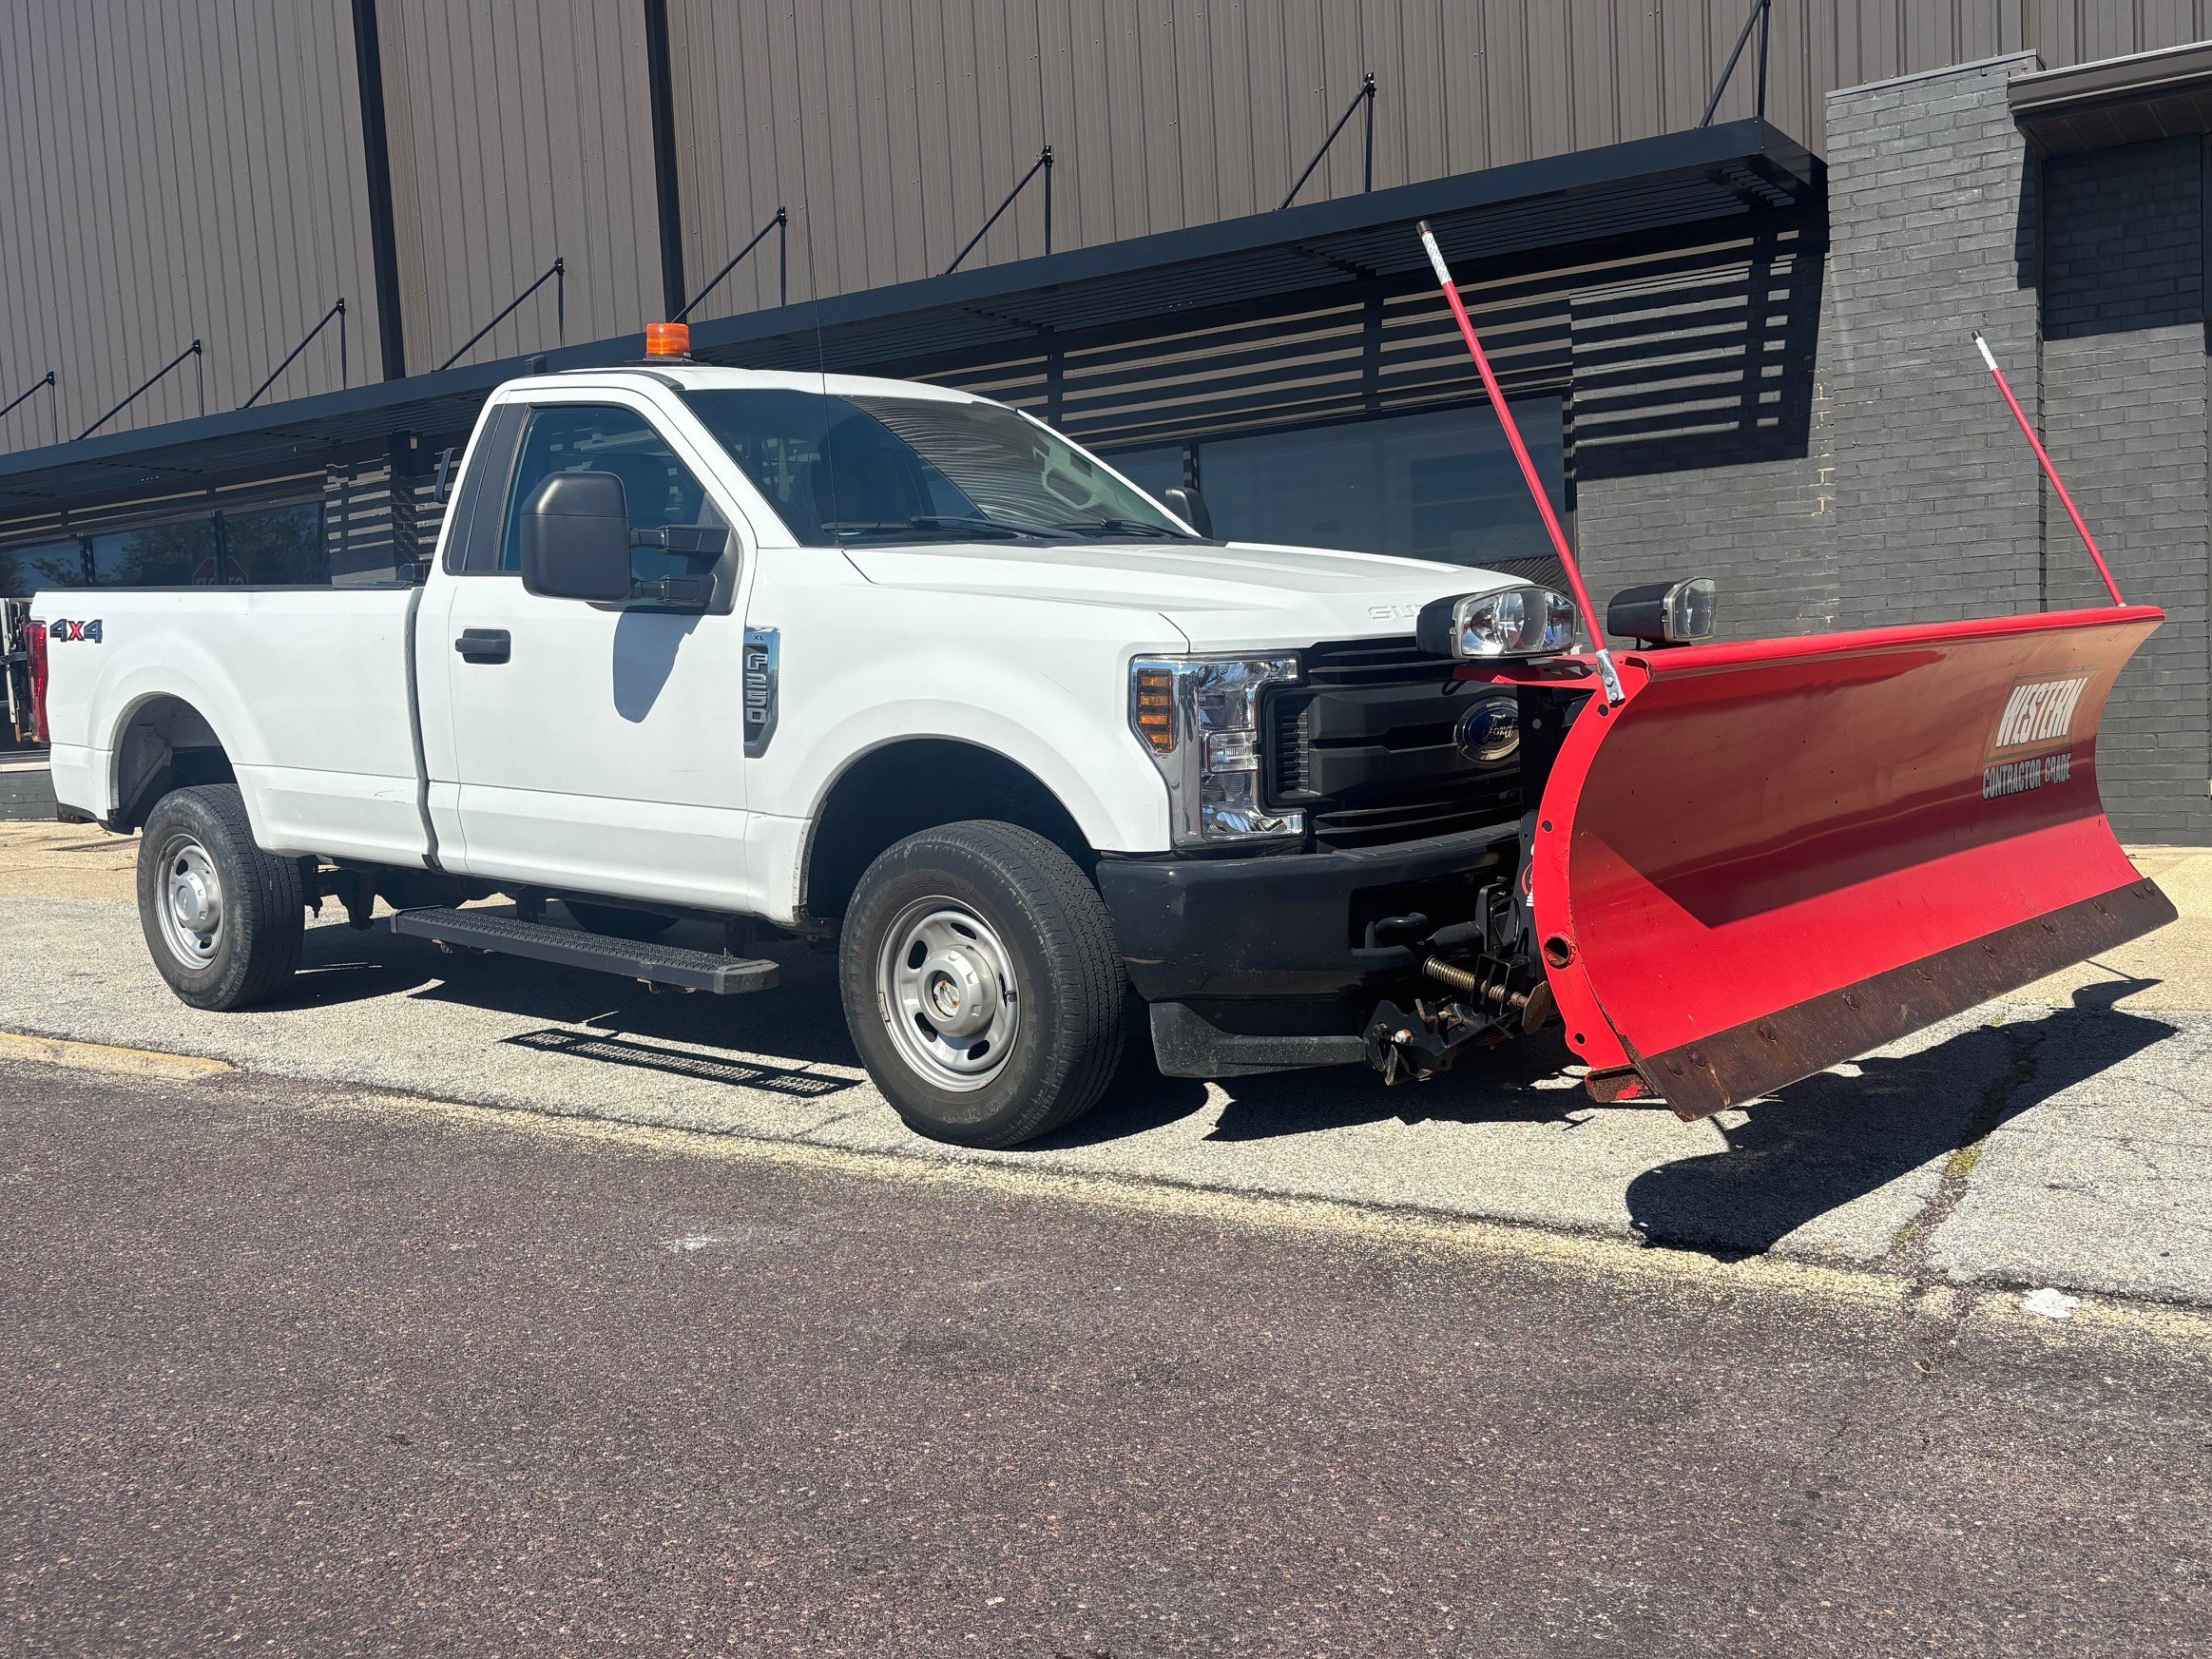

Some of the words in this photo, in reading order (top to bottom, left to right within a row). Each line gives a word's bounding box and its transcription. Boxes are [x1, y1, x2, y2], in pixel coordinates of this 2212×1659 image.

[1368, 605, 1424, 622] SU
[1484, 713, 1519, 740] Ford
[1996, 677, 2088, 747] WESTERN
[1982, 758, 2041, 801] CONTRACTOR
[2044, 752, 2071, 785] GRADE
